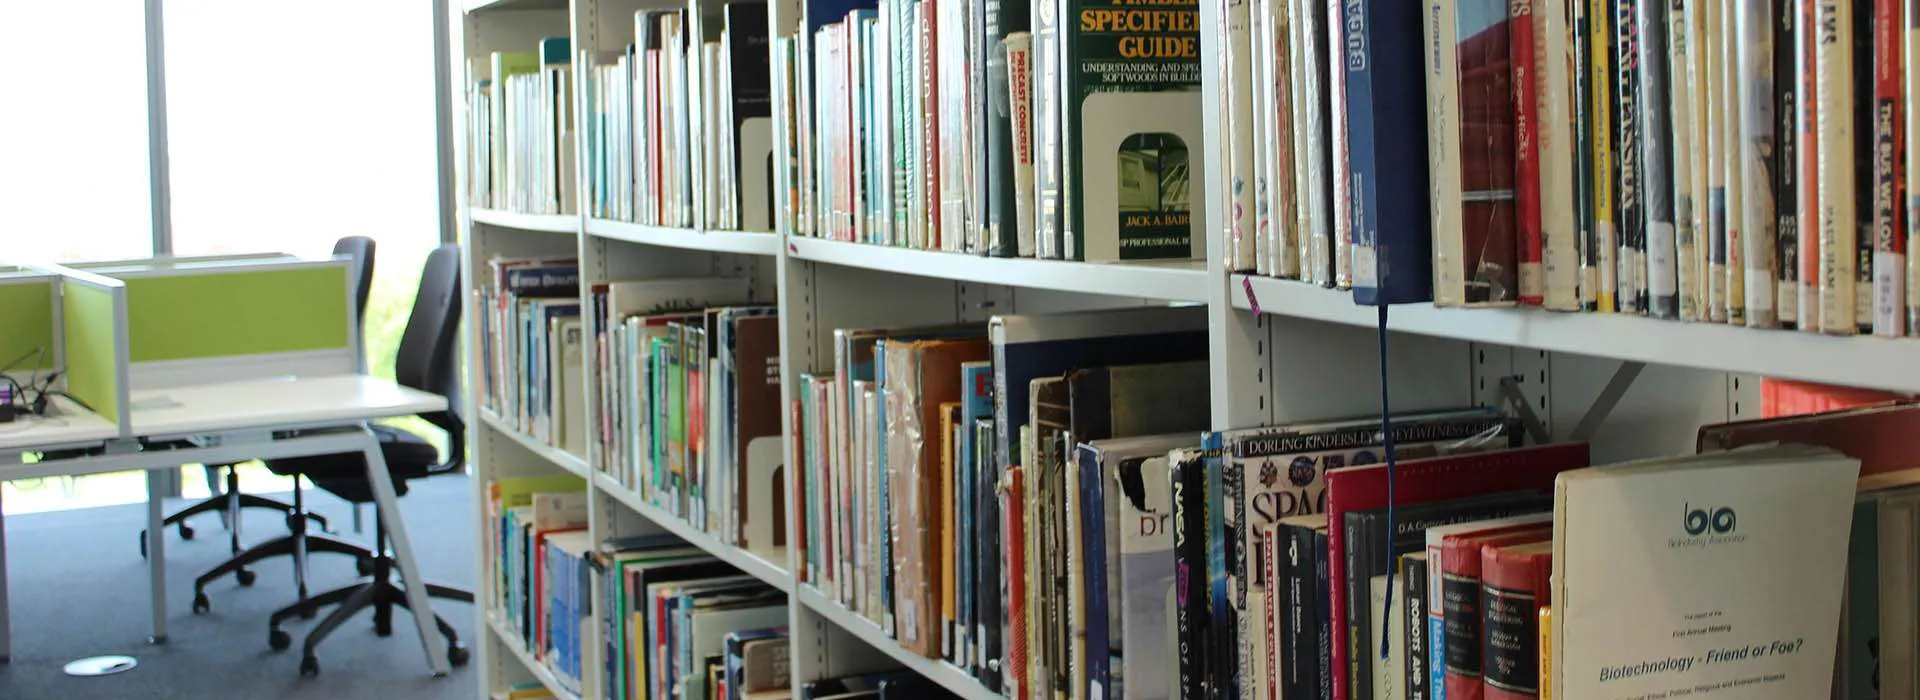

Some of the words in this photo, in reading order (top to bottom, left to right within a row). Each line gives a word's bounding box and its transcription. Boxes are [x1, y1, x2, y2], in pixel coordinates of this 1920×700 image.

[1118, 36, 1197, 58] GUIDE
[1016, 51, 1025, 101] PRECAST
[1082, 63, 1158, 73] UNDERSTANDING
[1160, 63, 1180, 73] AND
[1102, 72, 1158, 83] SOFTWOODS
[1018, 104, 1028, 164] CONCRETE
[1880, 103, 1894, 136] THE
[1881, 142, 1894, 175] BUS
[1881, 180, 1894, 211] WE
[1126, 215, 1150, 226] JACK
[1249, 438, 1302, 455] DORLING
[1304, 432, 1374, 450] KINDERSLEY
[1175, 481, 1185, 548] NASA
[1411, 597, 1421, 653] ROBOTS
[1432, 620, 1443, 673] Making
[1599, 655, 1695, 682] Biotechnology
[1706, 645, 1748, 665] Friend
[1752, 644, 1767, 657] or
[1769, 638, 1804, 655] Foe?
[1412, 655, 1422, 686] AND
